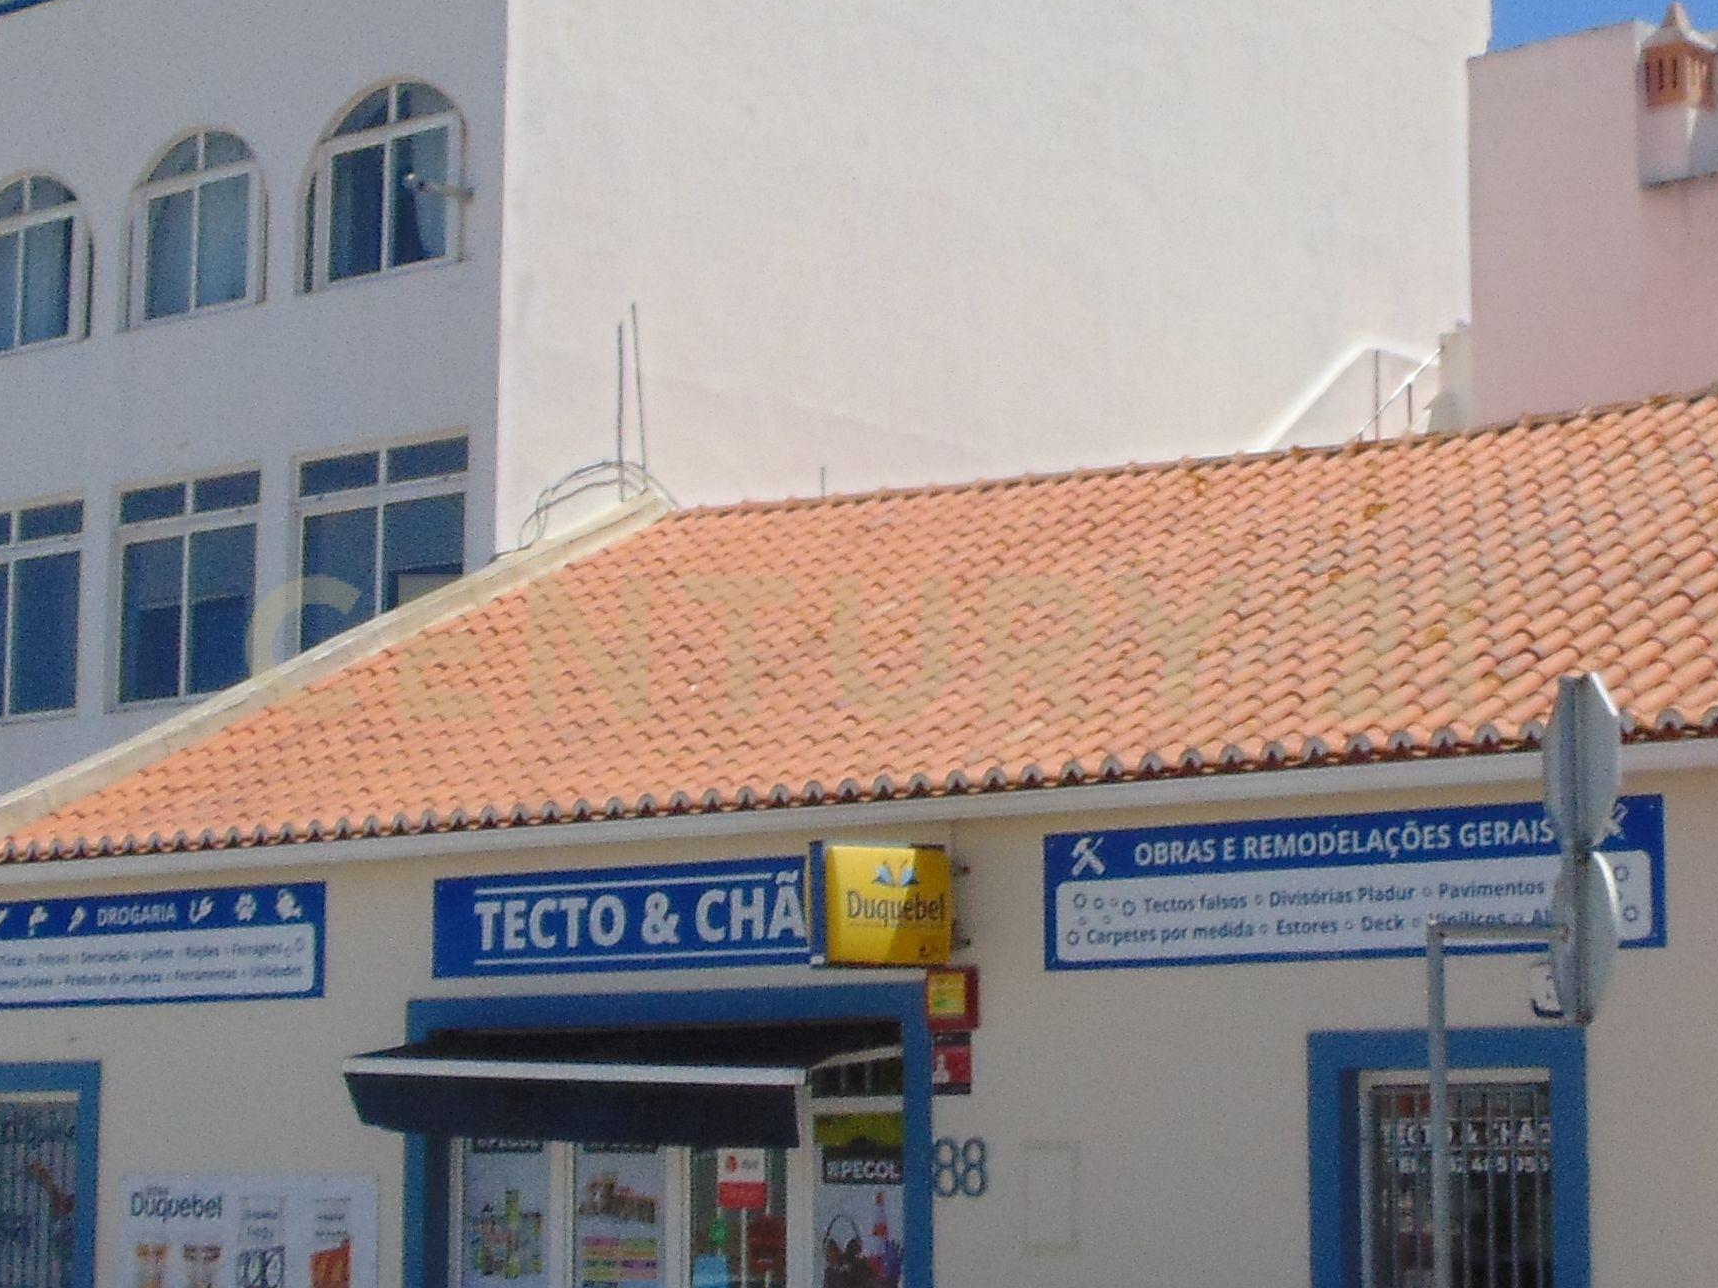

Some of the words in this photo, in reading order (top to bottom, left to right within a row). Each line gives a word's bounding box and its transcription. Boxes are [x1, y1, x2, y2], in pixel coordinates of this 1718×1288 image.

[1134, 838, 1216, 867] OBRAS
[1222, 836, 1236, 862] E
[1243, 819, 1452, 861] REMODELAÇÕES
[1458, 818, 1555, 849] GERAIS
[96, 902, 178, 928] DROGARIA
[473, 893, 626, 953] TECTO
[640, 891, 680, 946] &
[694, 868, 806, 945] CHÃ
[846, 890, 946, 929] Duquebel
[1143, 897, 1196, 914] Tectos
[1199, 892, 1248, 911] falsos
[1269, 887, 1353, 909] Divisórias
[1358, 884, 1416, 903] Pladur
[1438, 879, 1546, 900] Pavimentos
[1087, 927, 1157, 947] Carpetes
[1160, 927, 1188, 945] por
[1192, 919, 1254, 940] medida
[1276, 917, 1339, 936] Estores
[1360, 914, 1405, 932] Deck
[934, 1137, 987, 1198] 88
[129, 1192, 224, 1223] Duquebel
